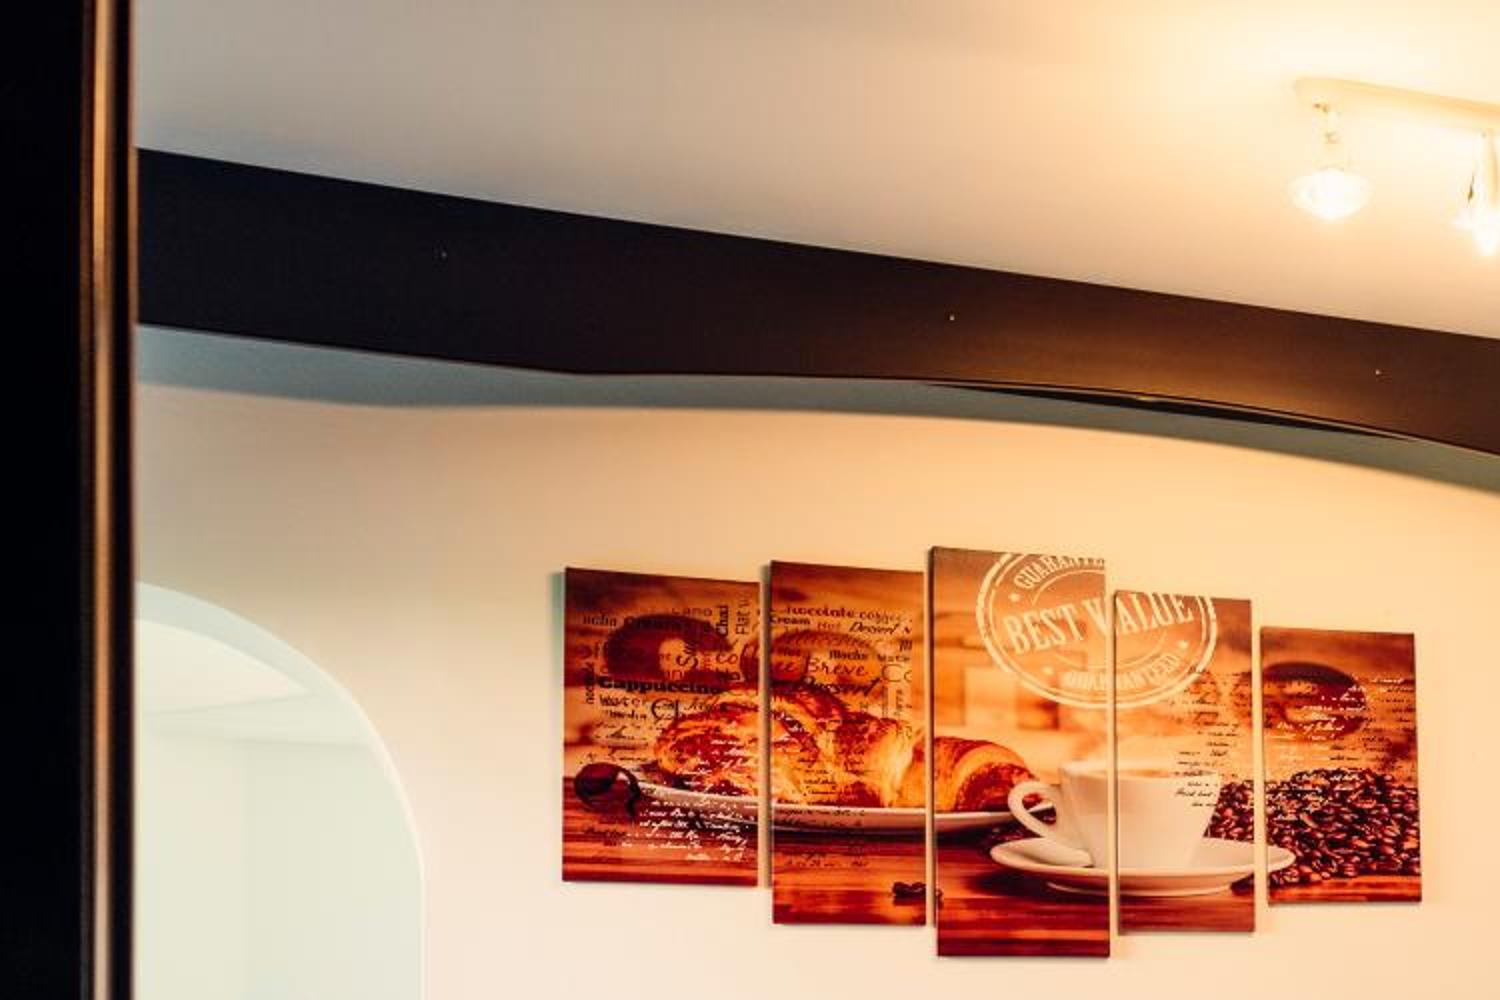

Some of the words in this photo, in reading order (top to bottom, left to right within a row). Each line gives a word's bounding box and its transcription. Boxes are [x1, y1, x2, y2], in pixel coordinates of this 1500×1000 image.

[1002, 602, 1084, 655] BEST
[1082, 592, 1195, 636] VALUE
[805, 653, 869, 678] Breve
[596, 676, 727, 696] Cappuccino
